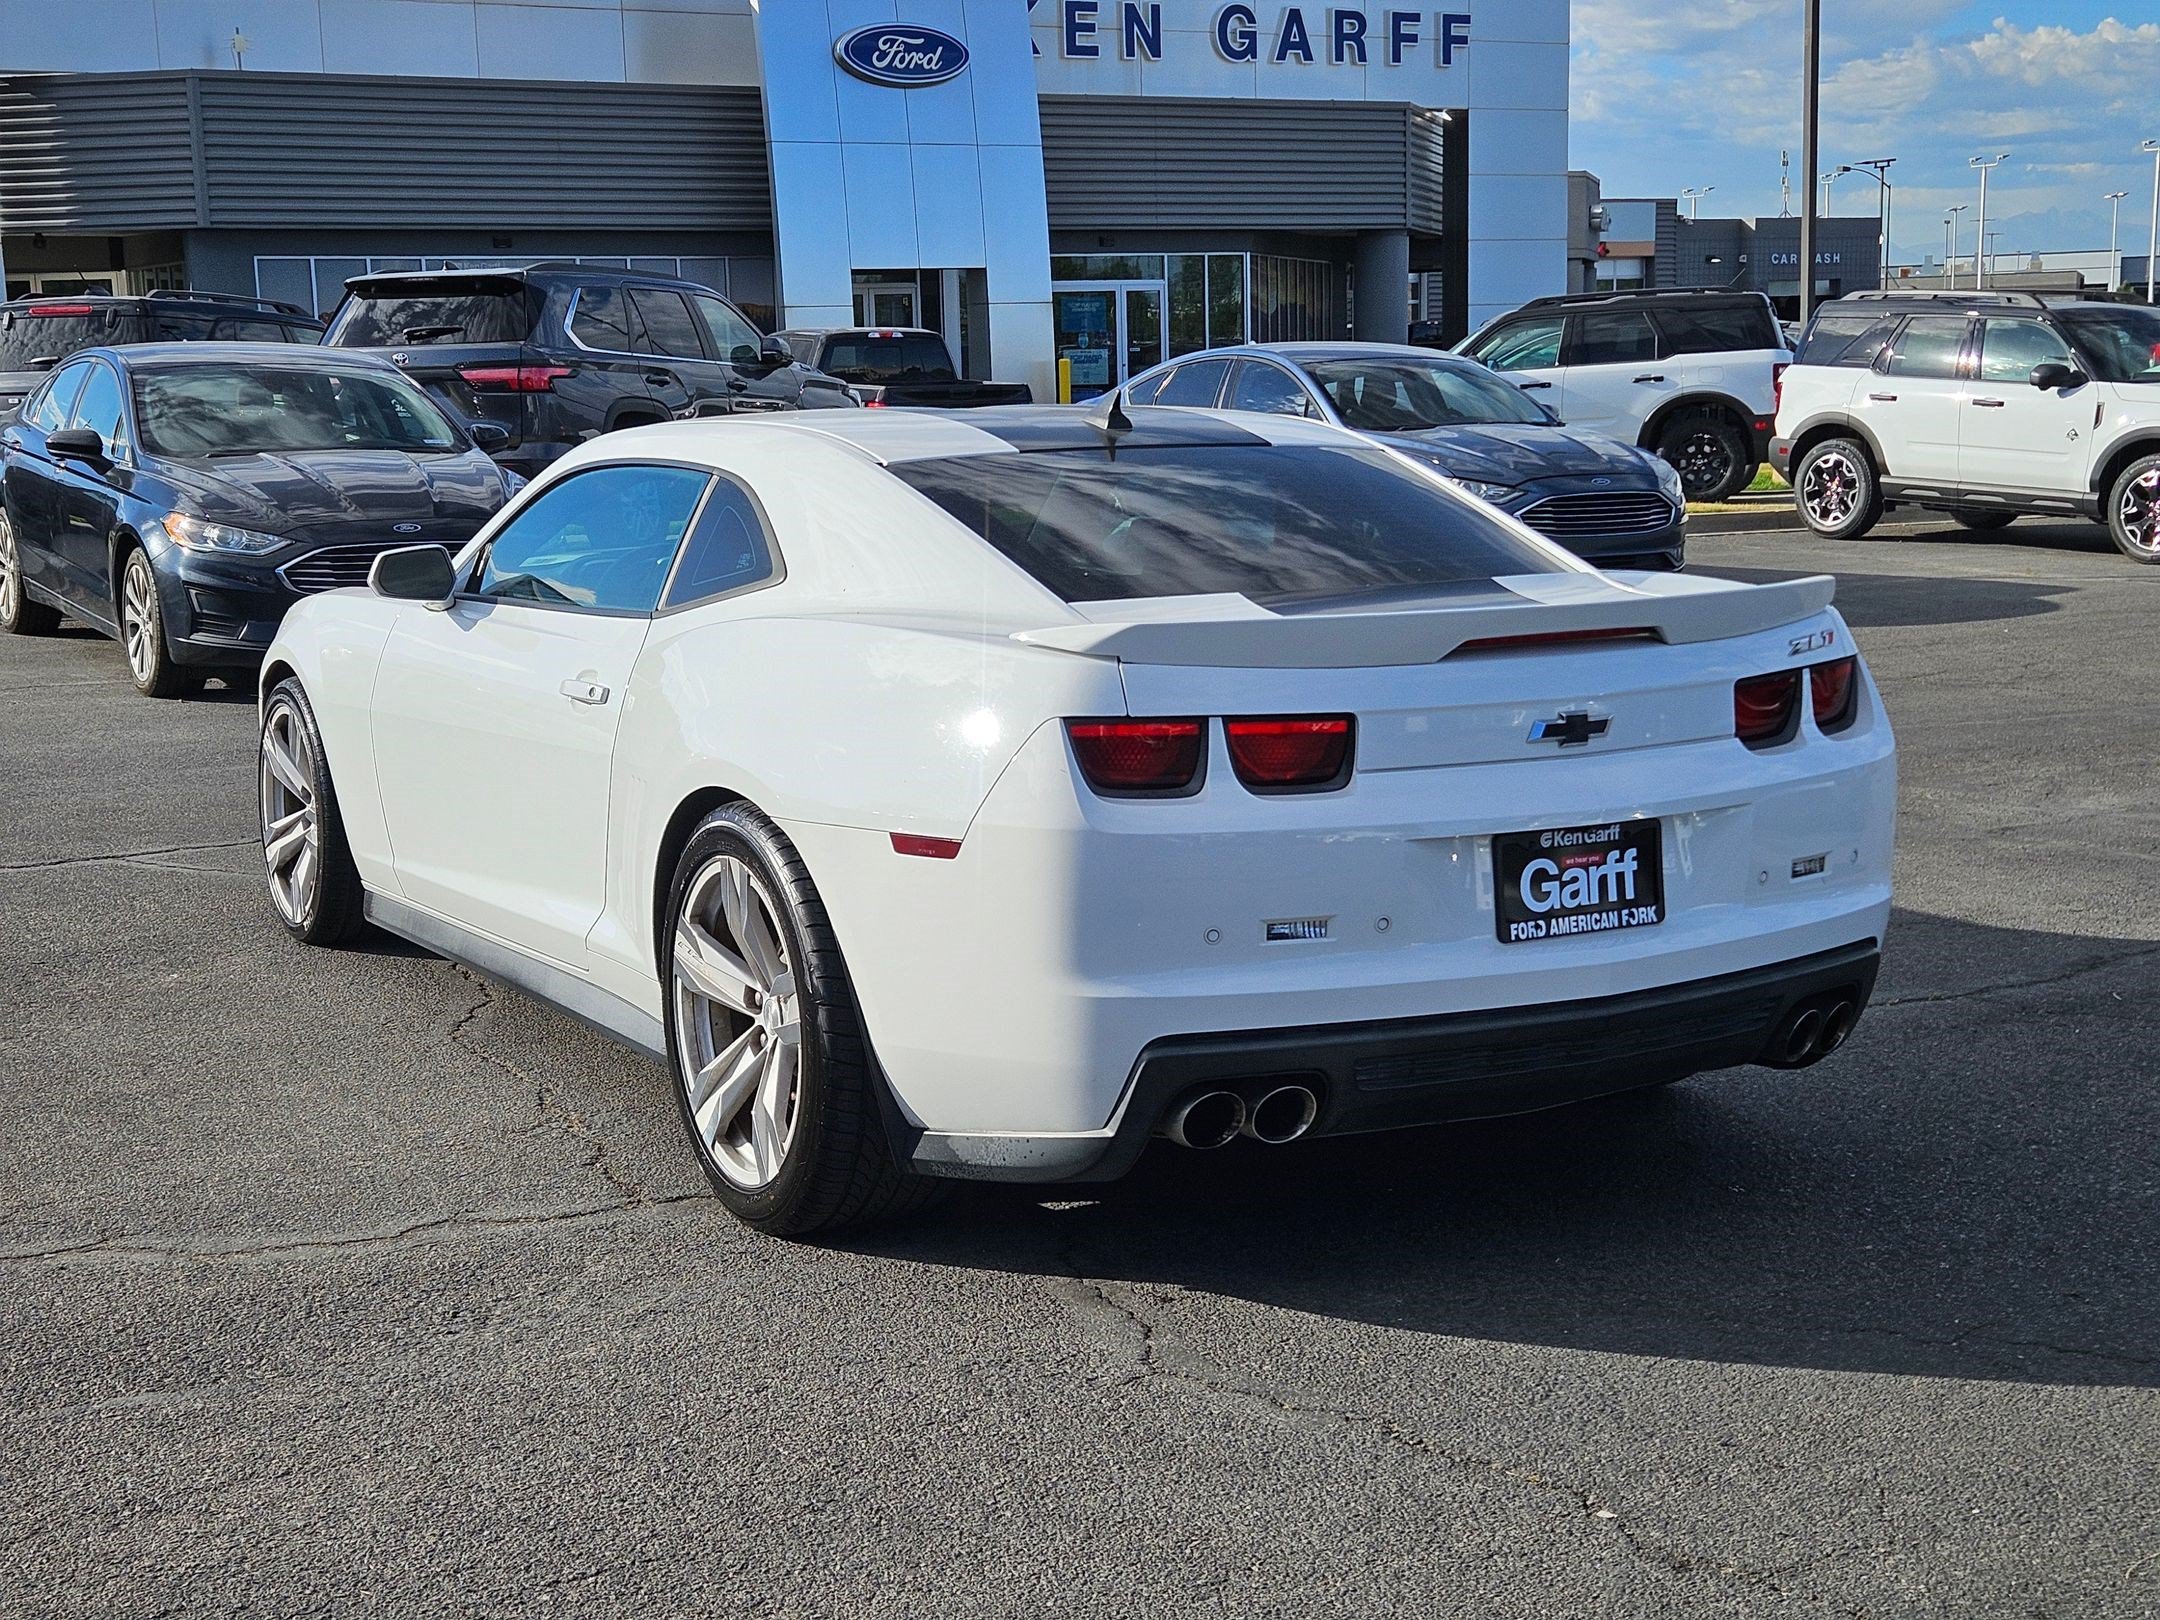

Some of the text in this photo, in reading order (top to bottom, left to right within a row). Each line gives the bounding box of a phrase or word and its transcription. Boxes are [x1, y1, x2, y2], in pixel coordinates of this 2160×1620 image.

[1215, 3, 1472, 68] GARFF
[872, 35, 943, 70] Ford
[1771, 252, 1841, 265] CAR ASH
[1575, 856, 1588, 864] hear
[1588, 855, 1600, 864] you
[1520, 848, 1638, 913] Garff
[1510, 920, 1546, 941] FORD
[1550, 910, 1619, 936] AMERICAN
